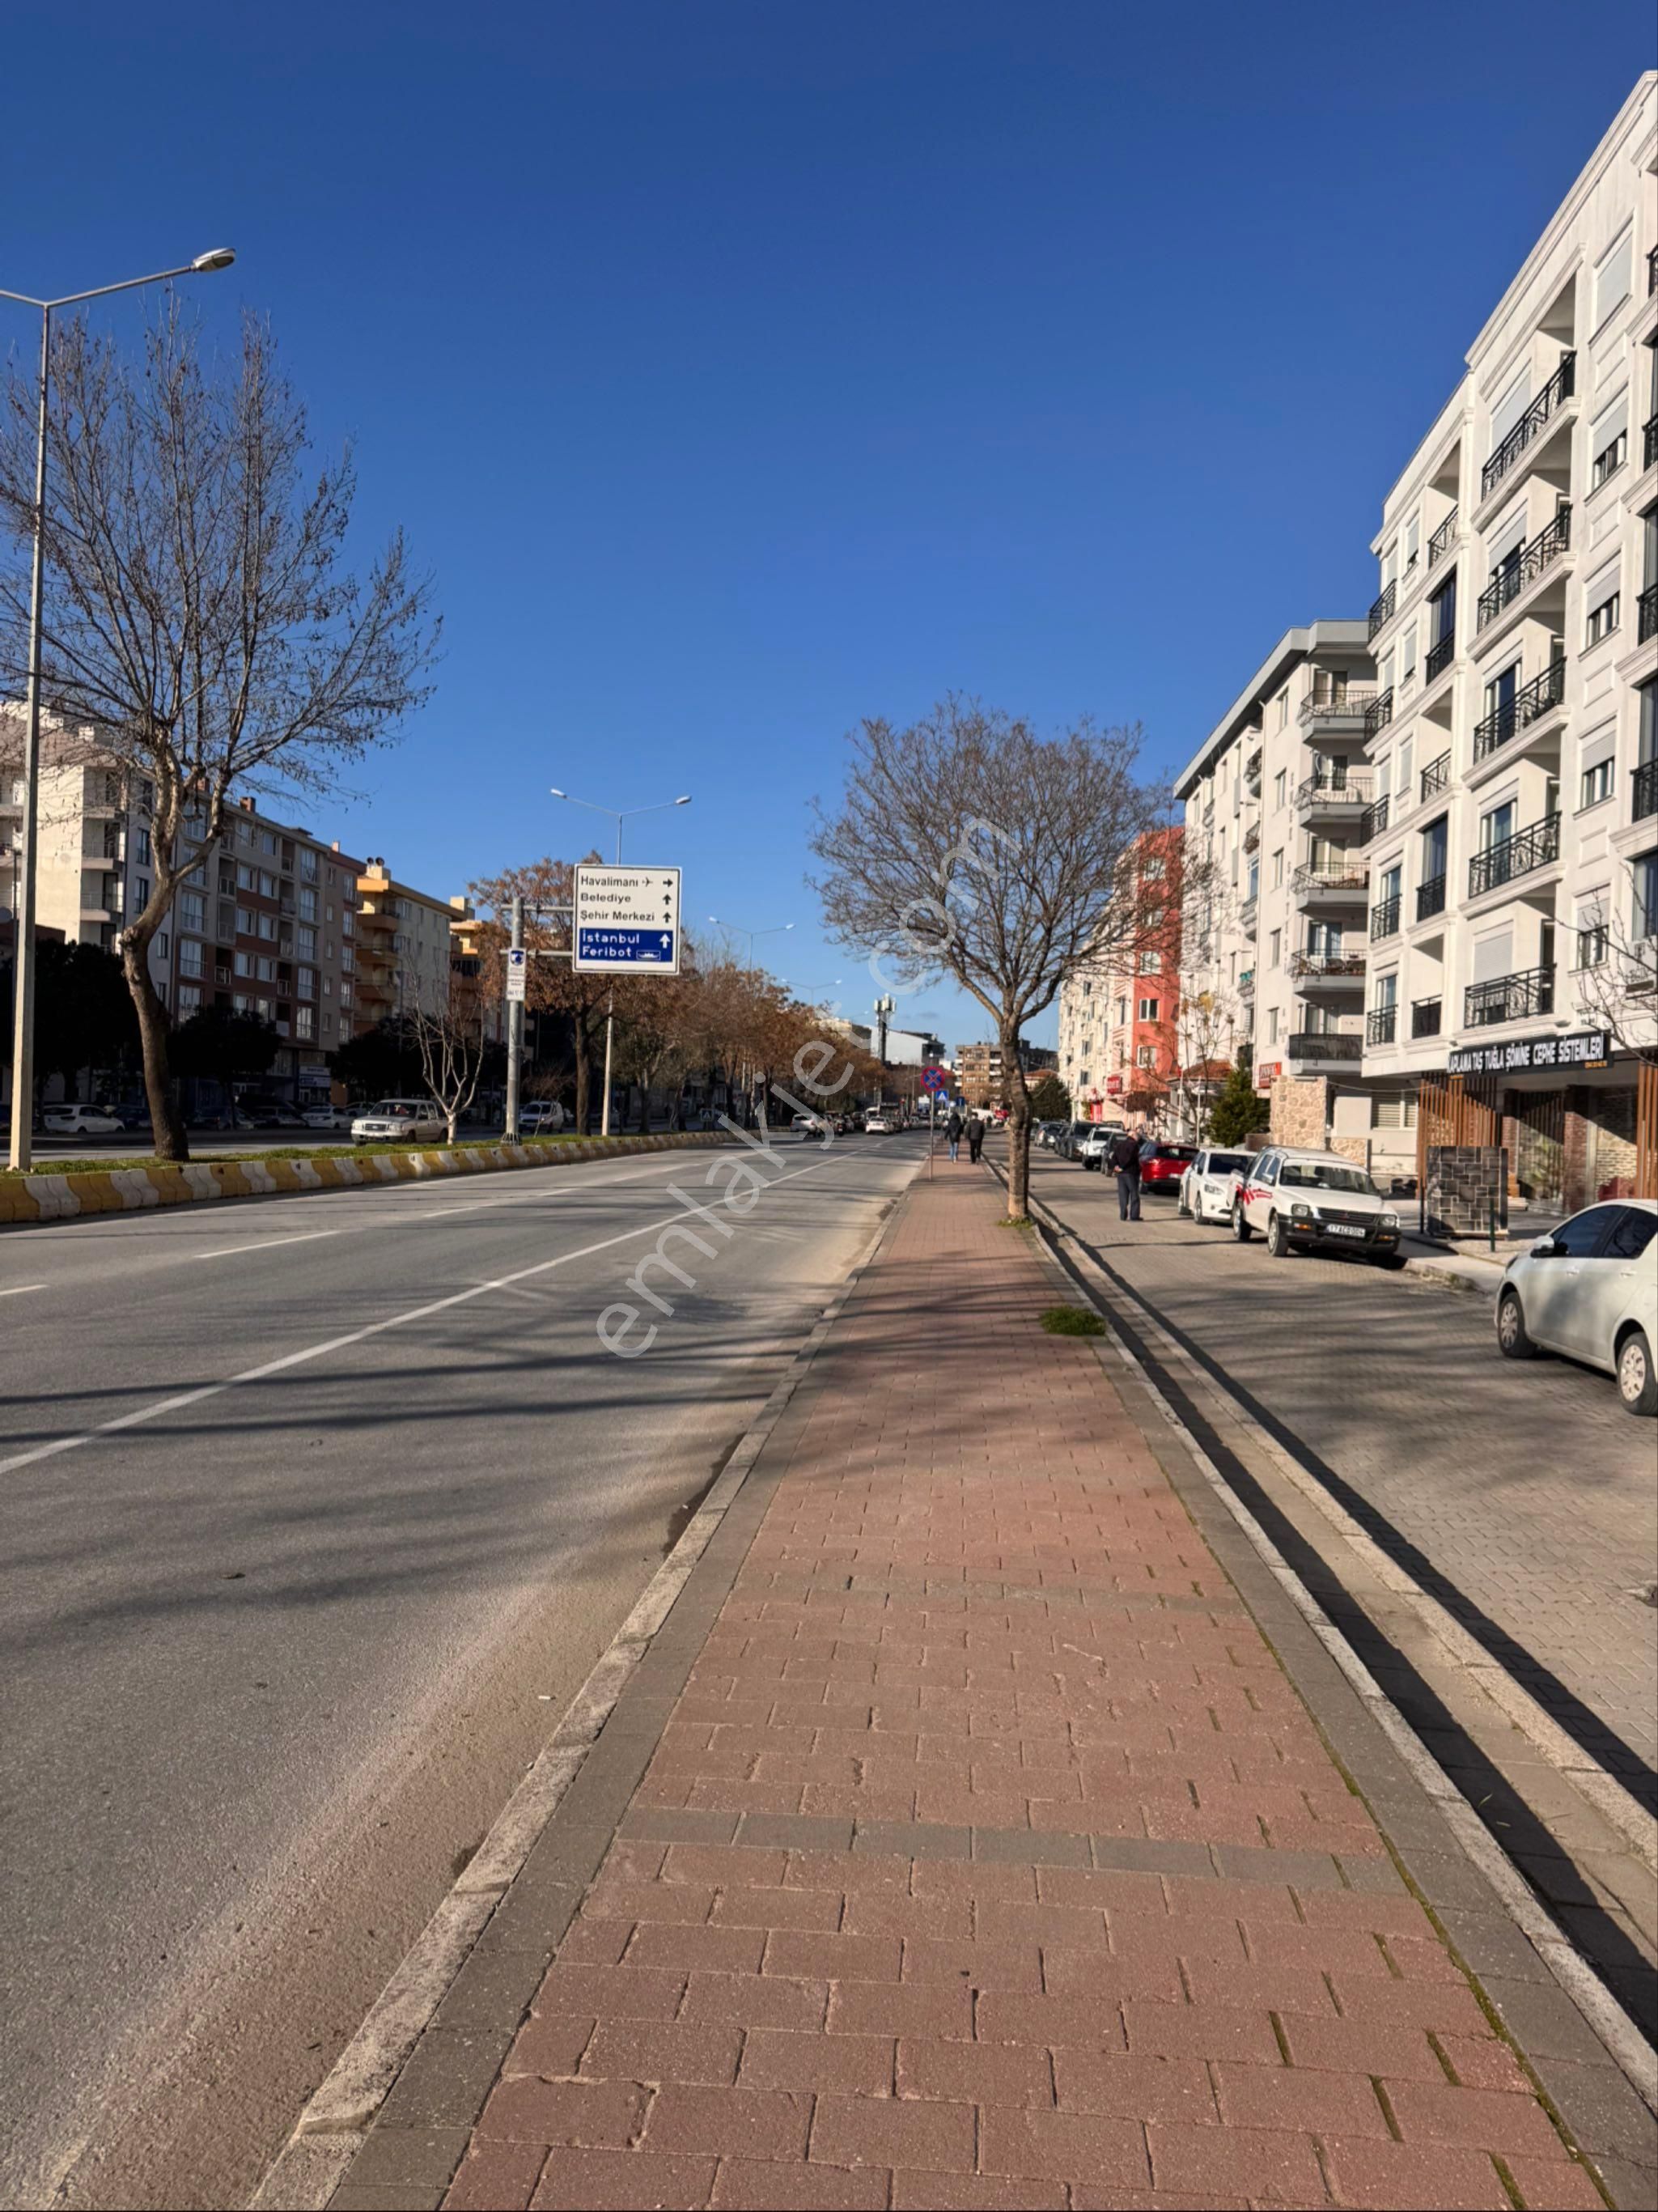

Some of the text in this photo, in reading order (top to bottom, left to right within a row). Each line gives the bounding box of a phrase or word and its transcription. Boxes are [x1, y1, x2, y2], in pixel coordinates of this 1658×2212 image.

[581, 875, 638, 887] Havalimanı
[580, 893, 631, 904] Belediye
[580, 911, 655, 922] Şehir Merkezi
[583, 929, 640, 945] İstanbul
[583, 945, 632, 957] Feribot
[1533, 1042, 1557, 1065] CEPHE
